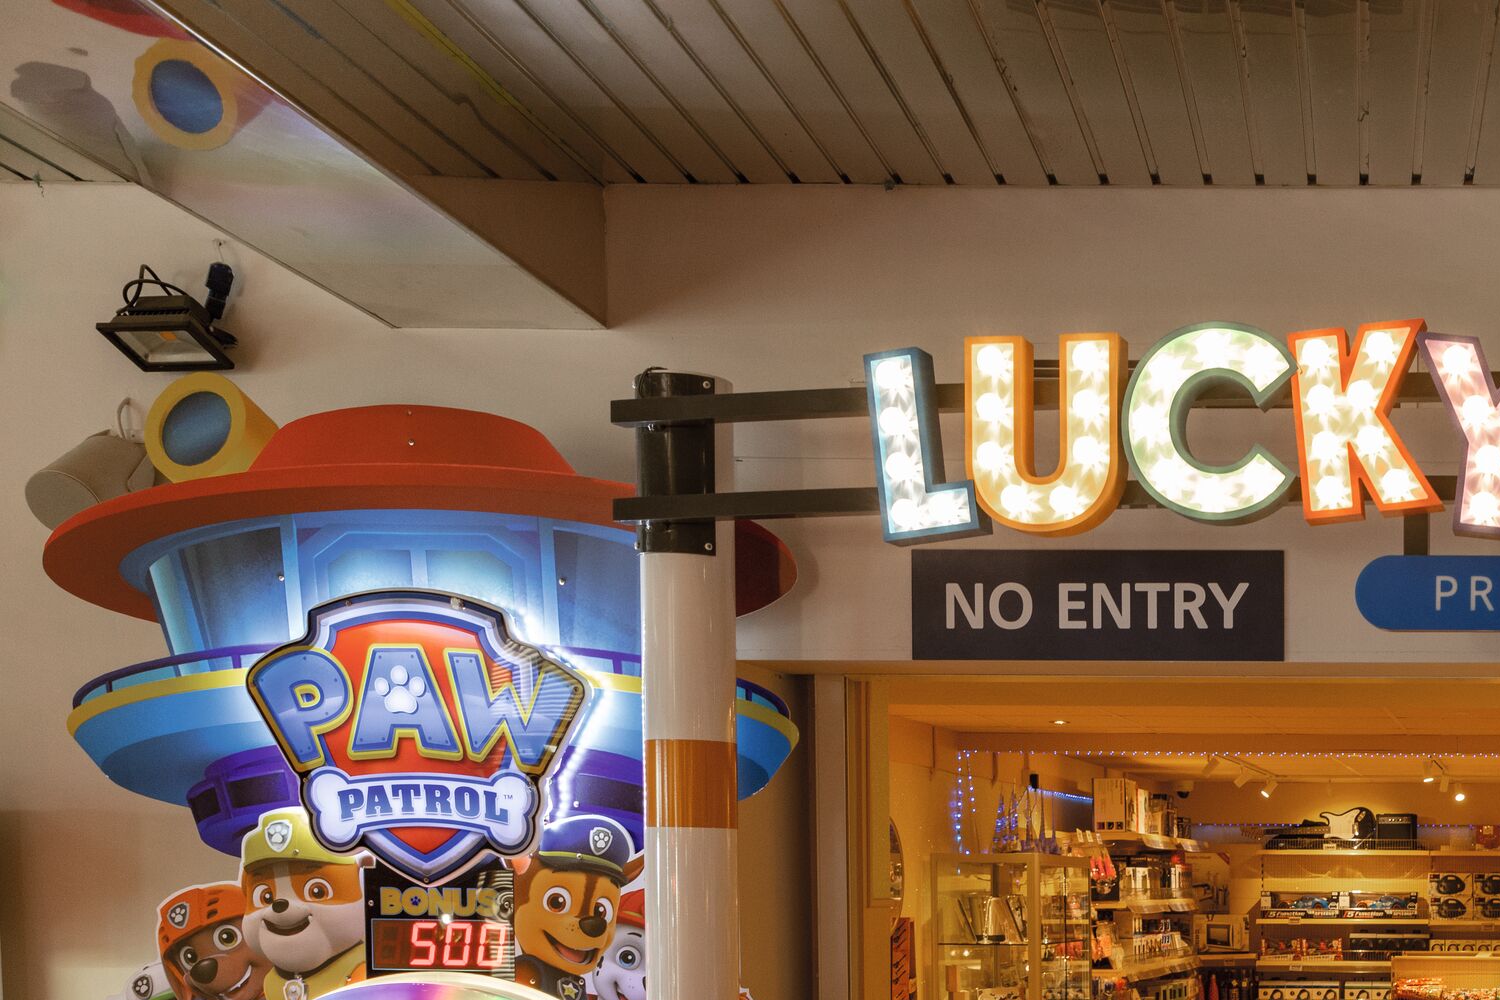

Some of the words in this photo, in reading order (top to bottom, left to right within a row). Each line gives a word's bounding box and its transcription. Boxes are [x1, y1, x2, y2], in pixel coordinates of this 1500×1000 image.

[944, 582, 1034, 630] NO
[1058, 582, 1250, 630] ENTRY
[248, 643, 579, 773] PAW
[337, 782, 508, 825] PATROL
[379, 886, 499, 917] BONUS
[409, 921, 507, 967] 500
